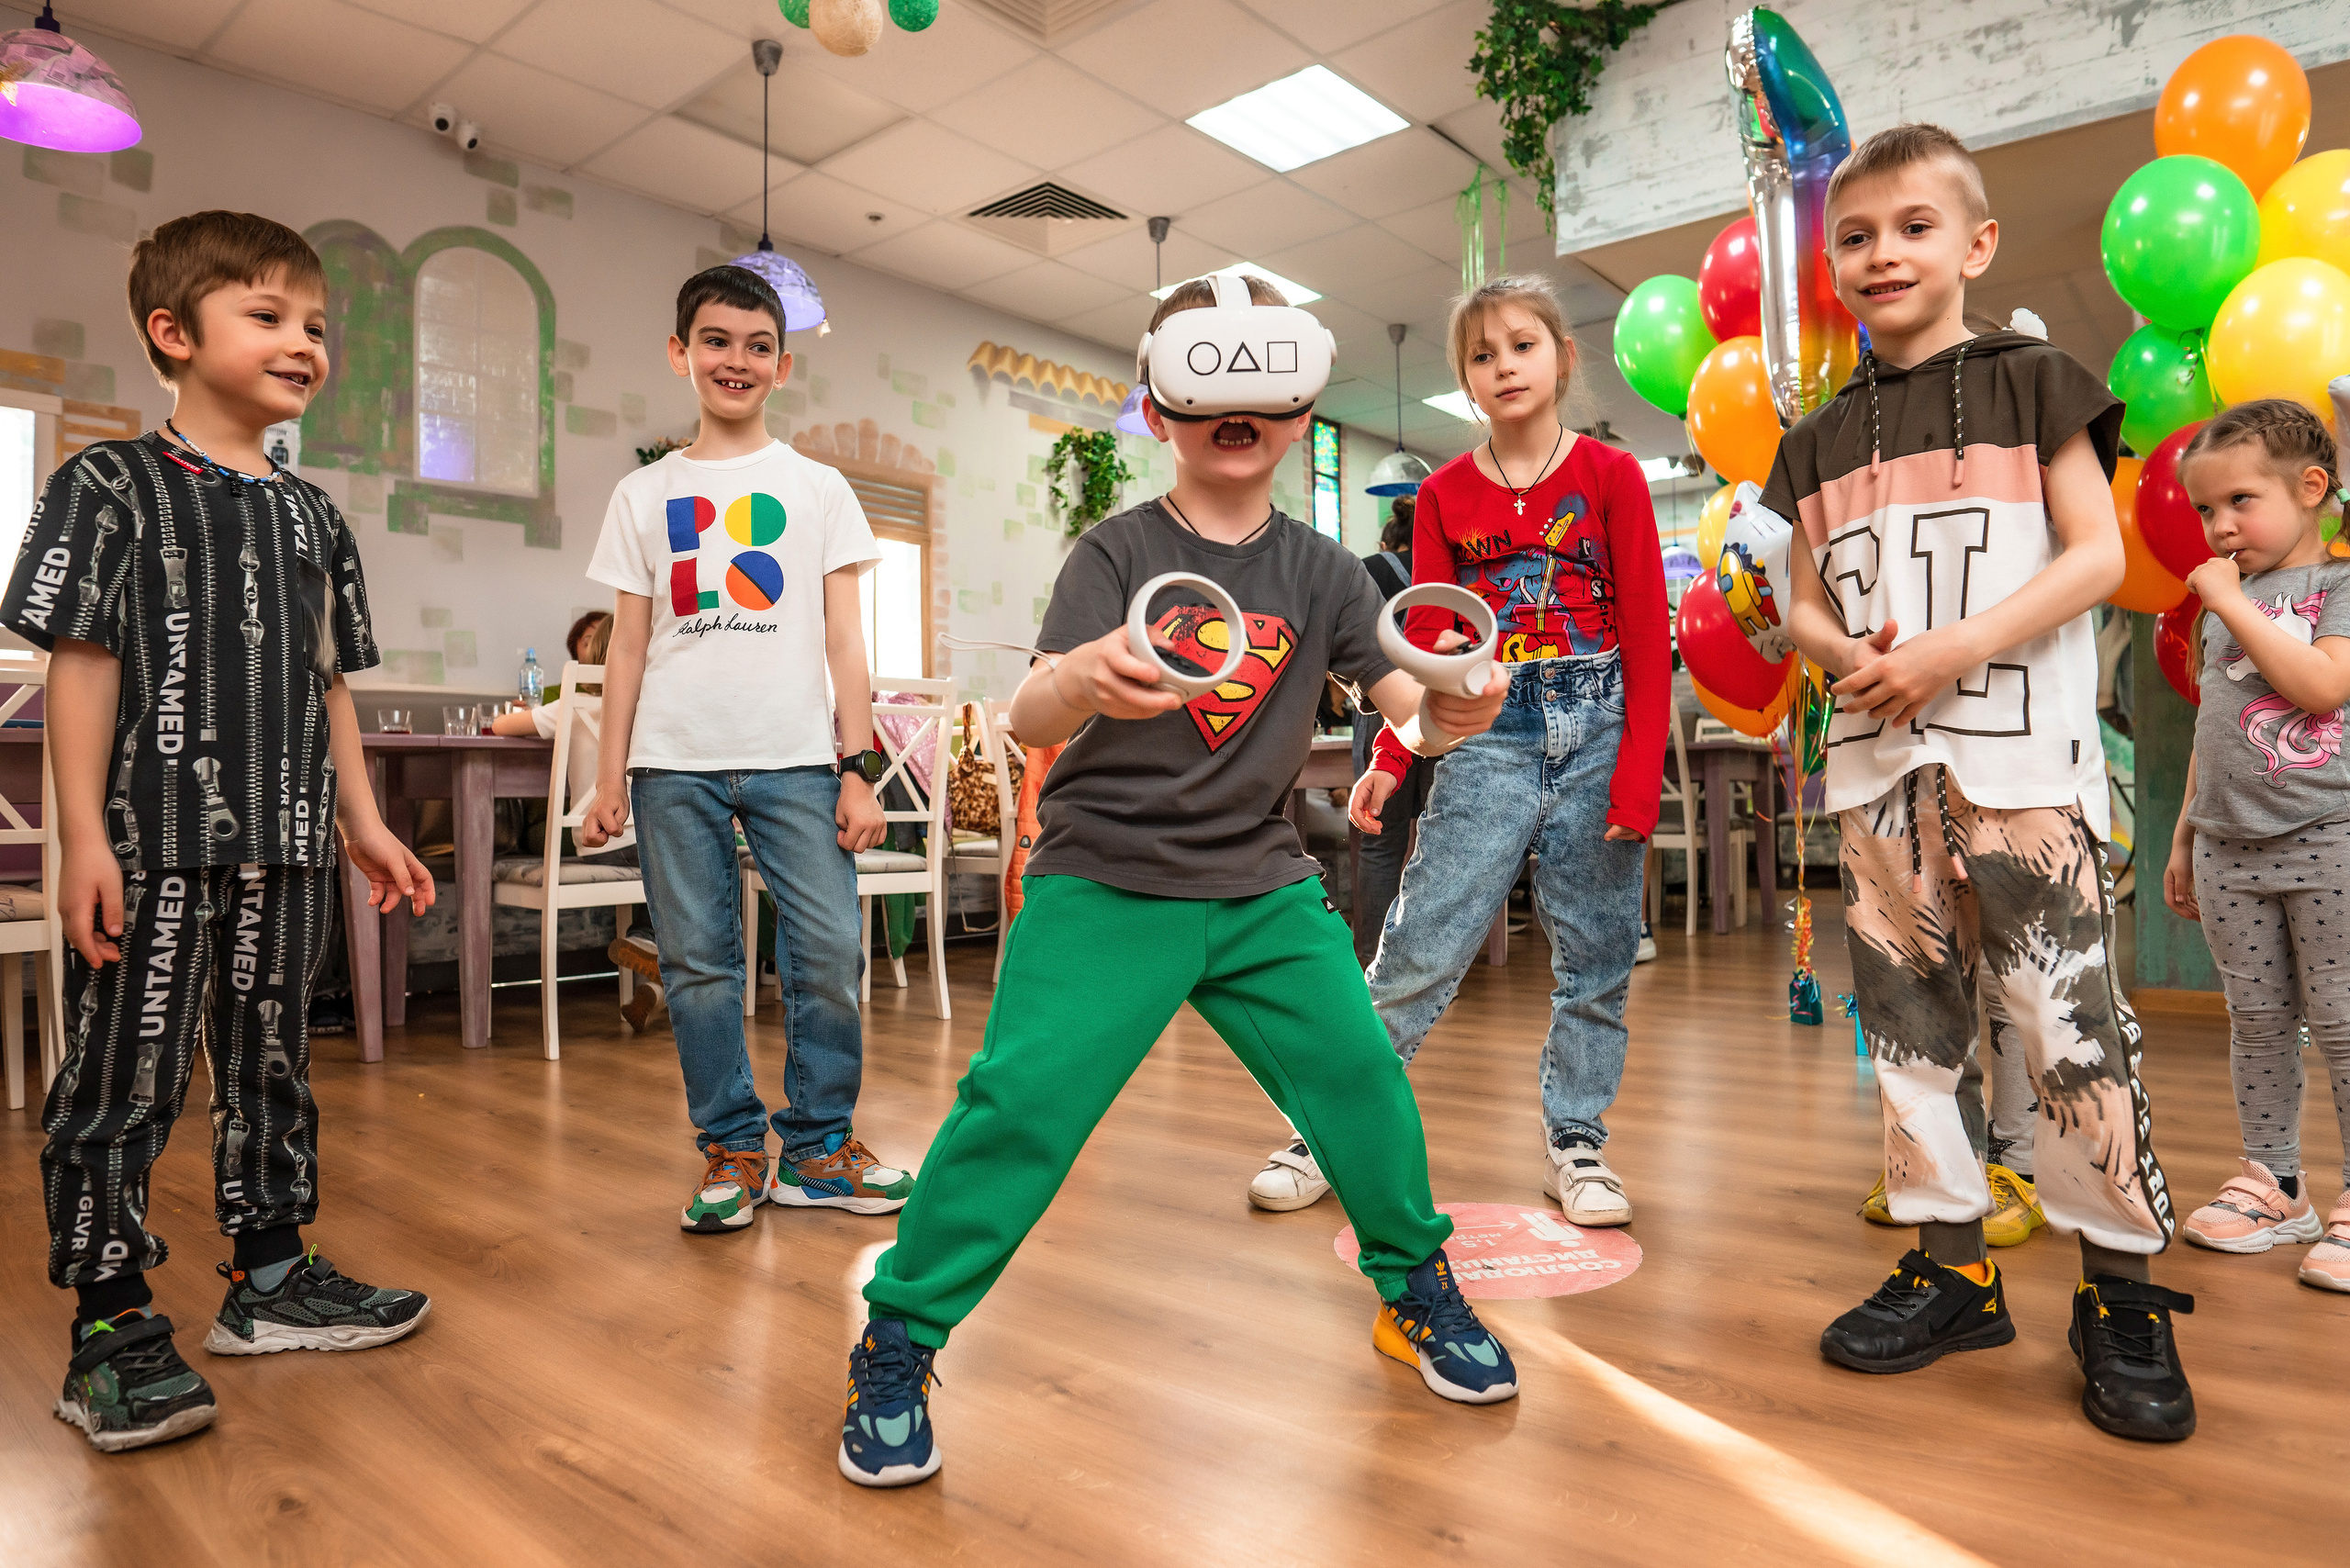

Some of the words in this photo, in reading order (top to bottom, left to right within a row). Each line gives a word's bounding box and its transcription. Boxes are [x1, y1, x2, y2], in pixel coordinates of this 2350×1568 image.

[18, 547, 72, 631] AMED
[672, 615, 722, 638] Ralph
[724, 612, 778, 633] Lauren
[157, 612, 190, 755] UNTAMED
[280, 757, 290, 806] GLVR
[295, 800, 309, 867] MED
[139, 876, 186, 1037] UNTAMED
[231, 864, 268, 991] NTAMED
[71, 1195, 95, 1251] GLVR
[1460, 1238, 1498, 1249] 1,5
